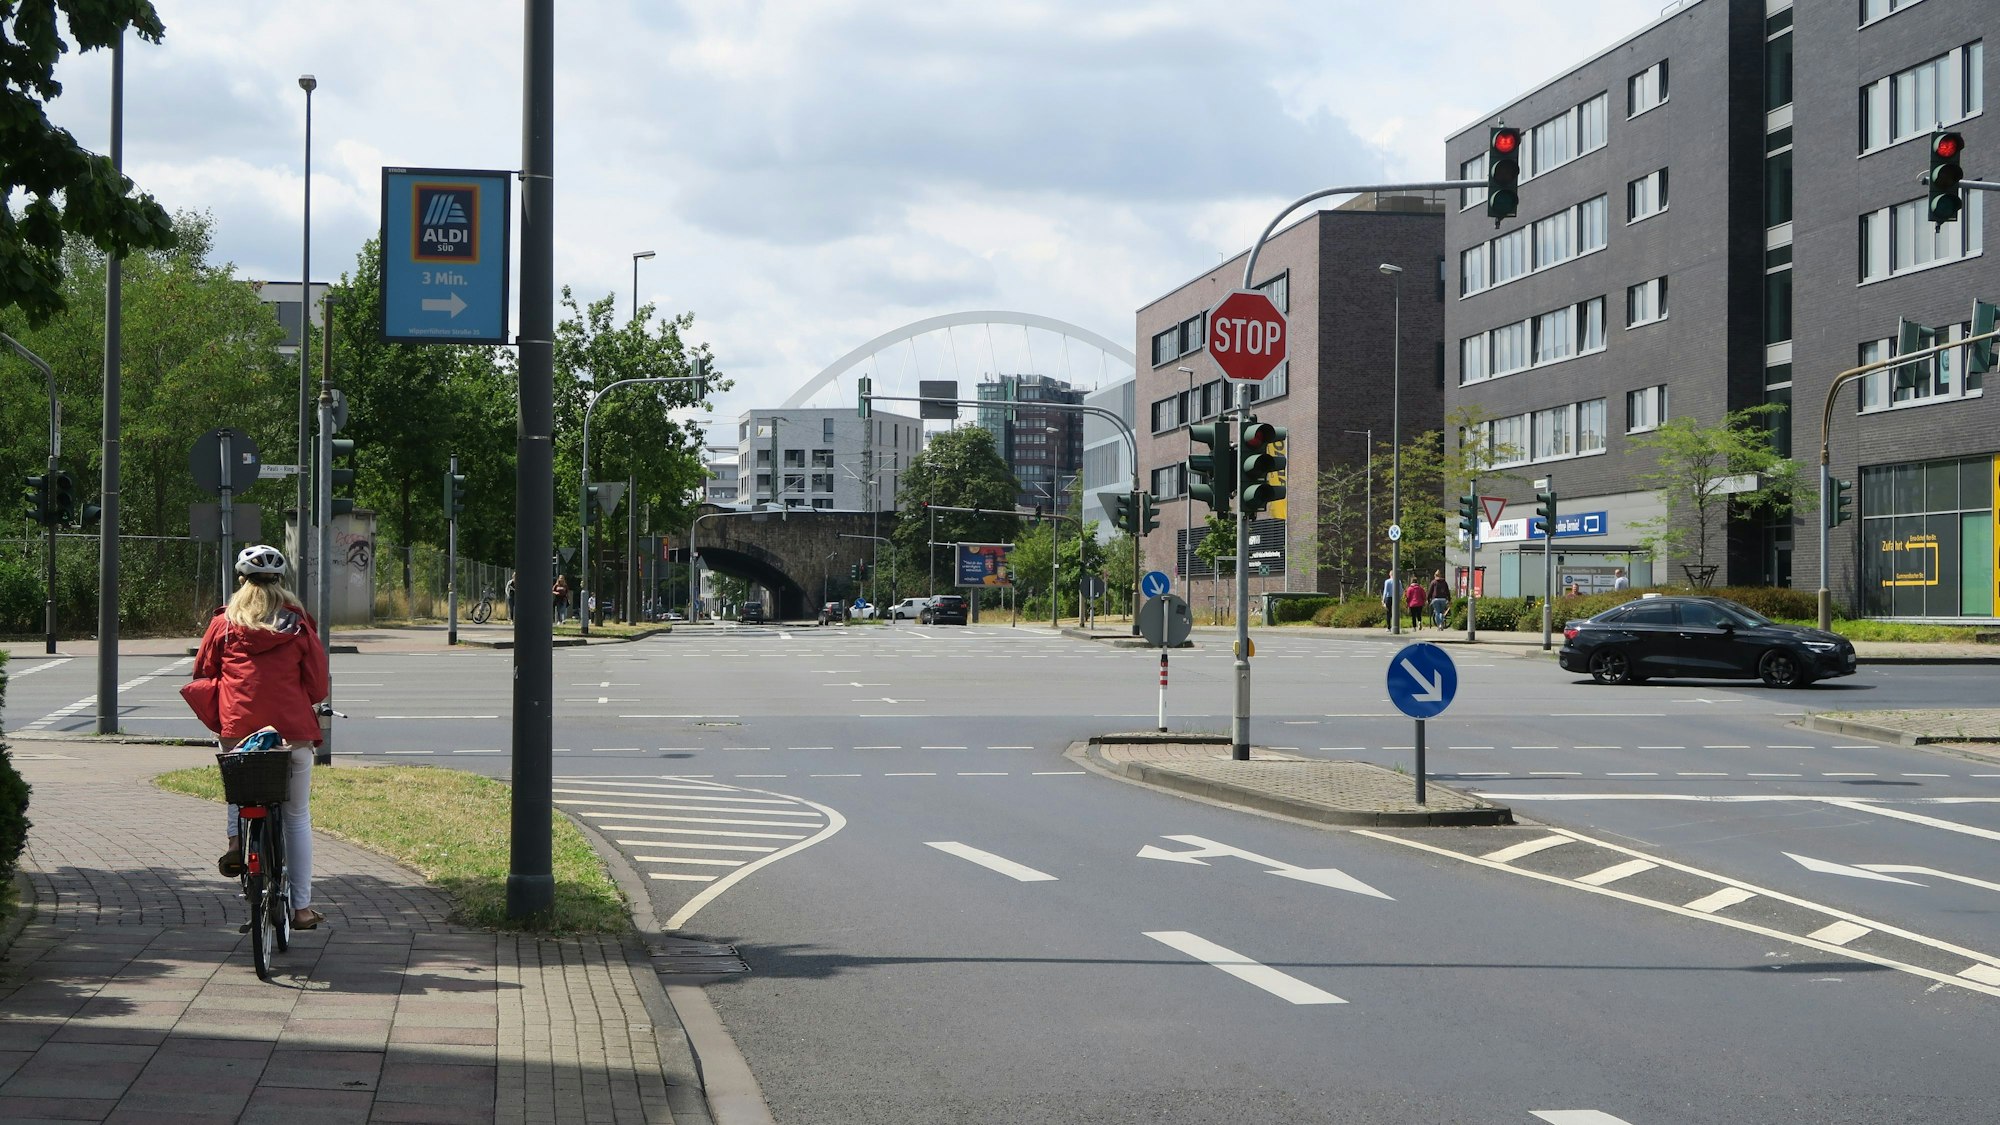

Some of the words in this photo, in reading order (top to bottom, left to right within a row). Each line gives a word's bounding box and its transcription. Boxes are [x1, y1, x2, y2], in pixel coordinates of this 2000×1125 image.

[423, 229, 468, 243] ALDI
[437, 243, 454, 252] SÜD
[422, 272, 431, 285] 3
[435, 271, 468, 286] Min.
[1214, 317, 1281, 356] STOP
[1882, 540, 1903, 552] Zufahrt
